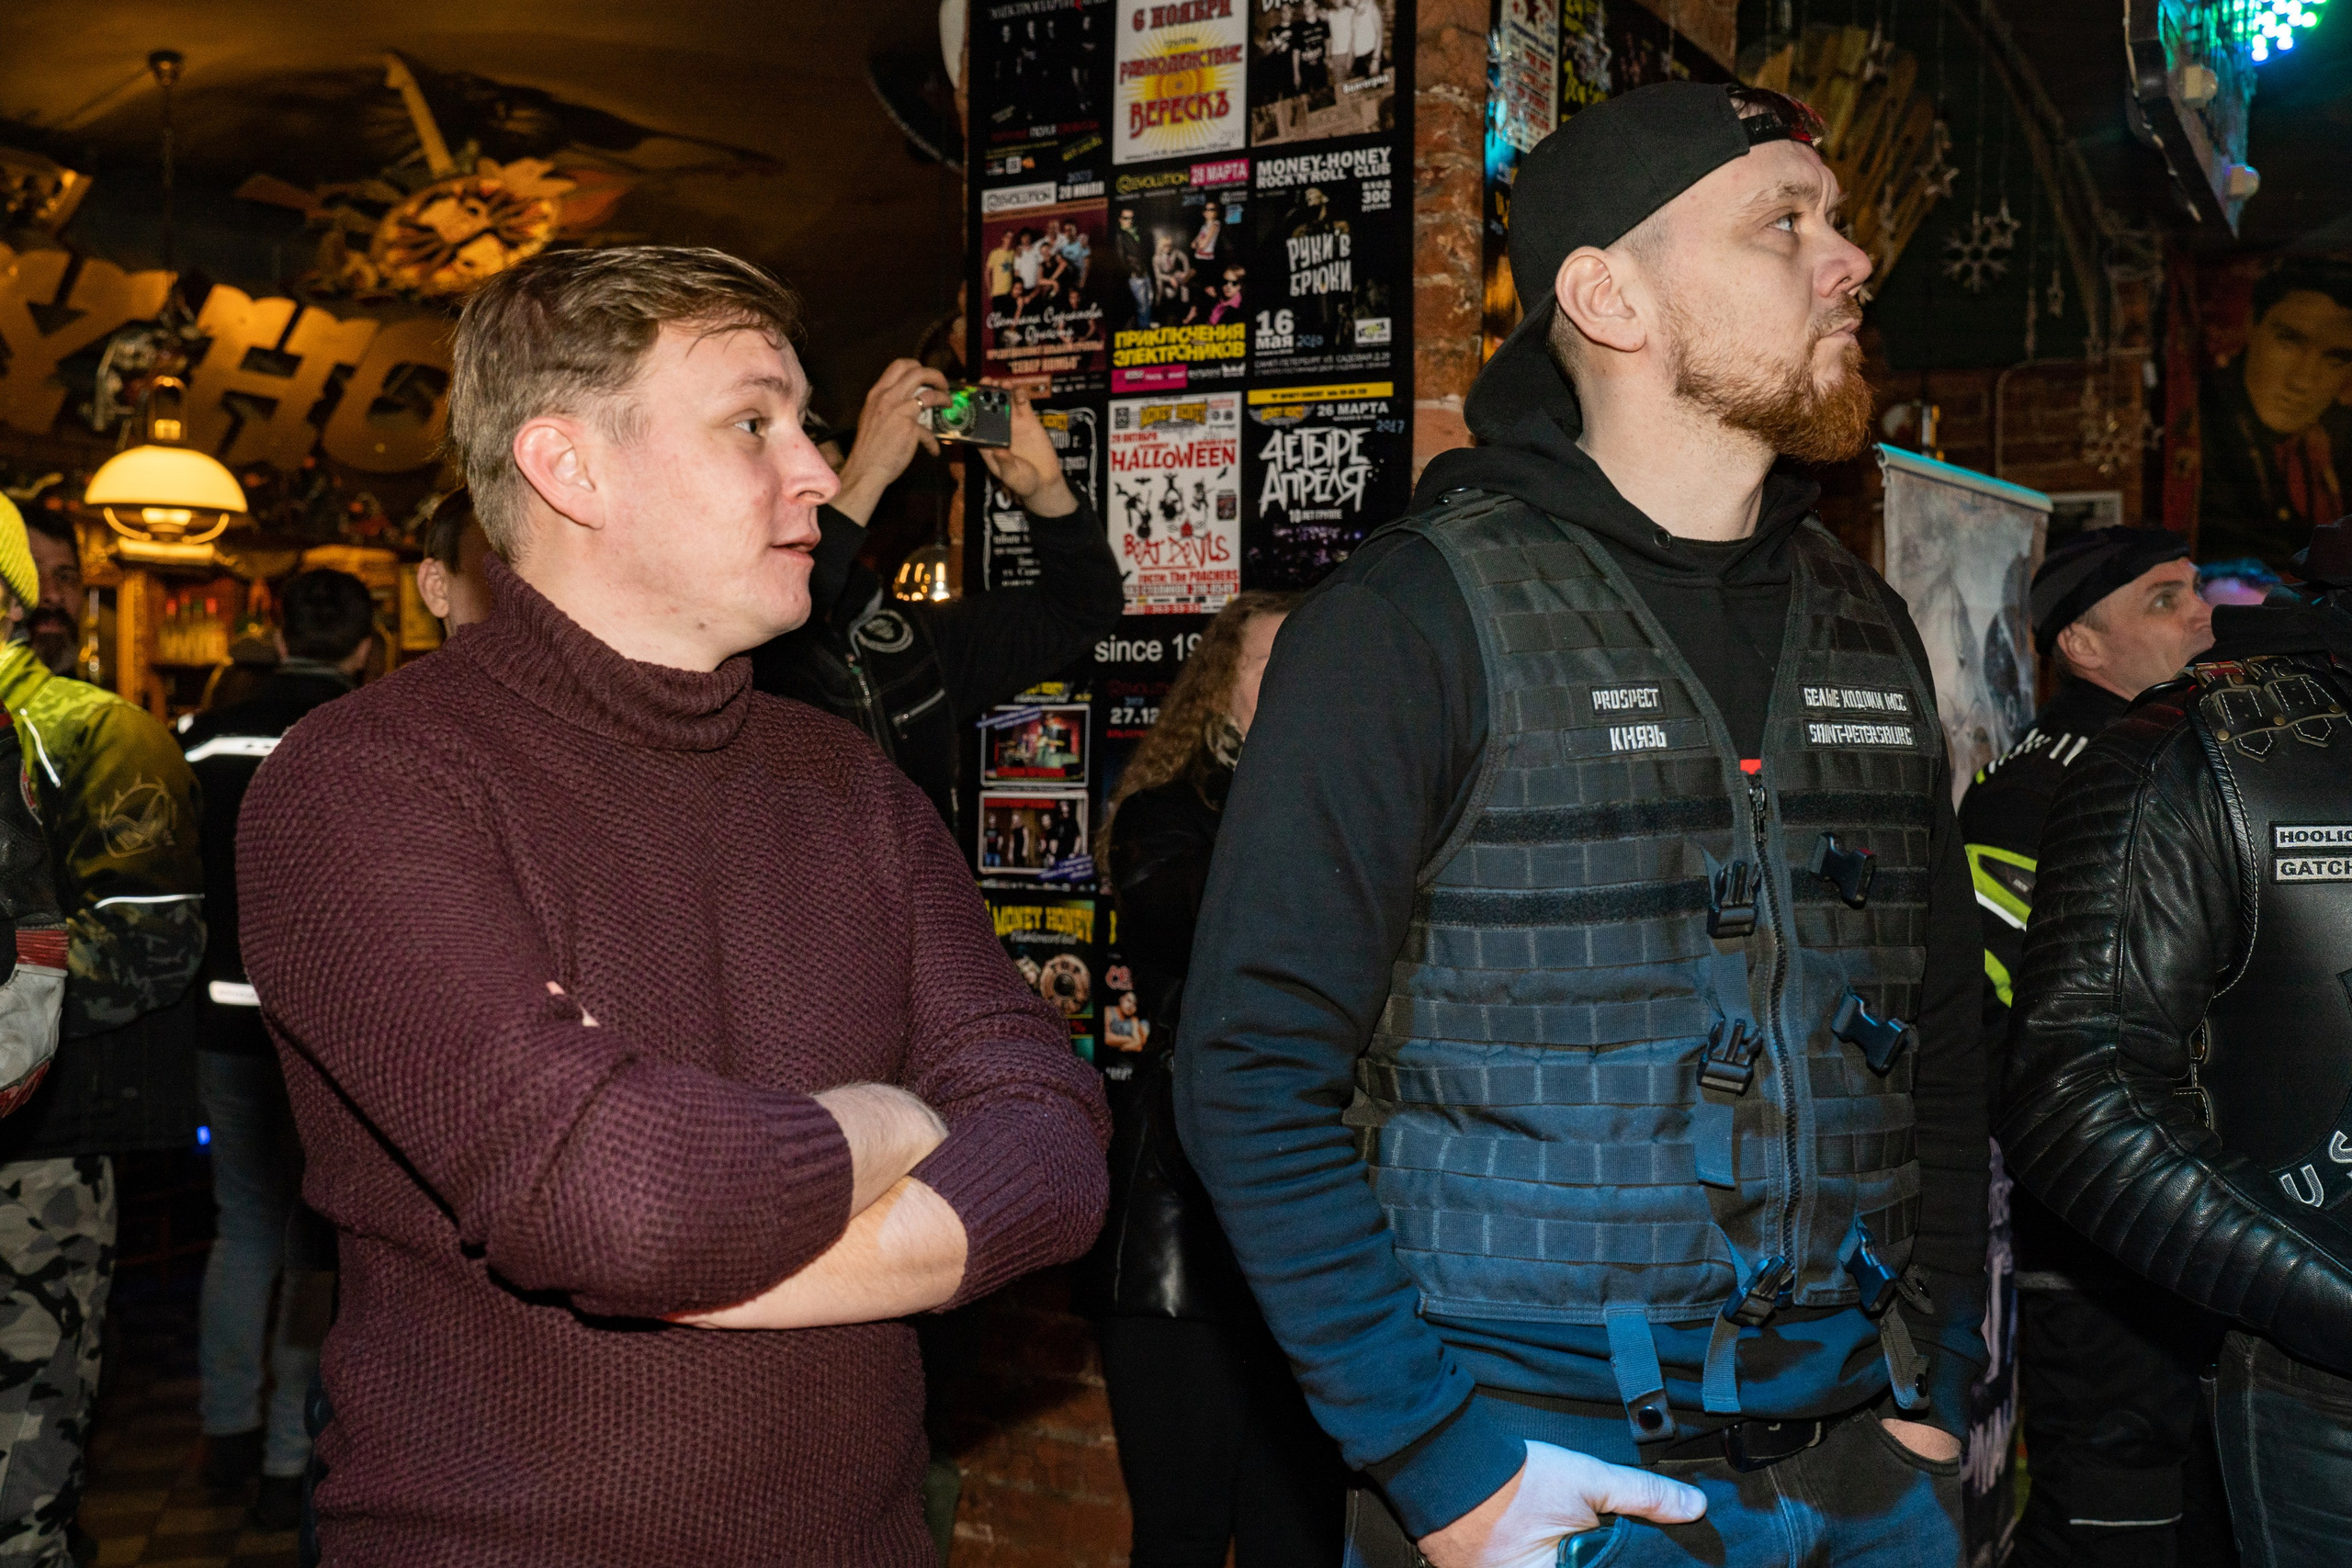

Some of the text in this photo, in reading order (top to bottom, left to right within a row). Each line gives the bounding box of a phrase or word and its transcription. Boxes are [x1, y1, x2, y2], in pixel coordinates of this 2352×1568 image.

[1132, 8, 1145, 32] 6
[1205, 161, 1249, 182] МАРТА
[1256, 147, 1392, 175] MONEY-HONEY
[1353, 163, 1392, 179] CLUB
[1362, 190, 1392, 203] 300
[1290, 259, 1352, 297] БРЮКИ
[1114, 322, 1247, 349] ПРИКЛЮЧЕНИЯ
[1255, 309, 1295, 337] 16
[1255, 333, 1295, 349] мая
[1113, 341, 1247, 367] ЭЛЕКТРОНИКОВ
[1316, 401, 1389, 418] 26 МАРТА
[1111, 442, 1236, 471] HALLOWEEN
[1258, 461, 1374, 519] АПРЕЛЯ
[1094, 633, 1164, 662] since
[1591, 688, 1659, 710] PROSPECT
[1804, 687, 1840, 709] БЕЛЫЕ
[1843, 689, 1883, 711] ХОДОКИ
[1610, 724, 1668, 751] КНЯЗЬ
[1807, 723, 1913, 746] SAINT-PETERSBURG
